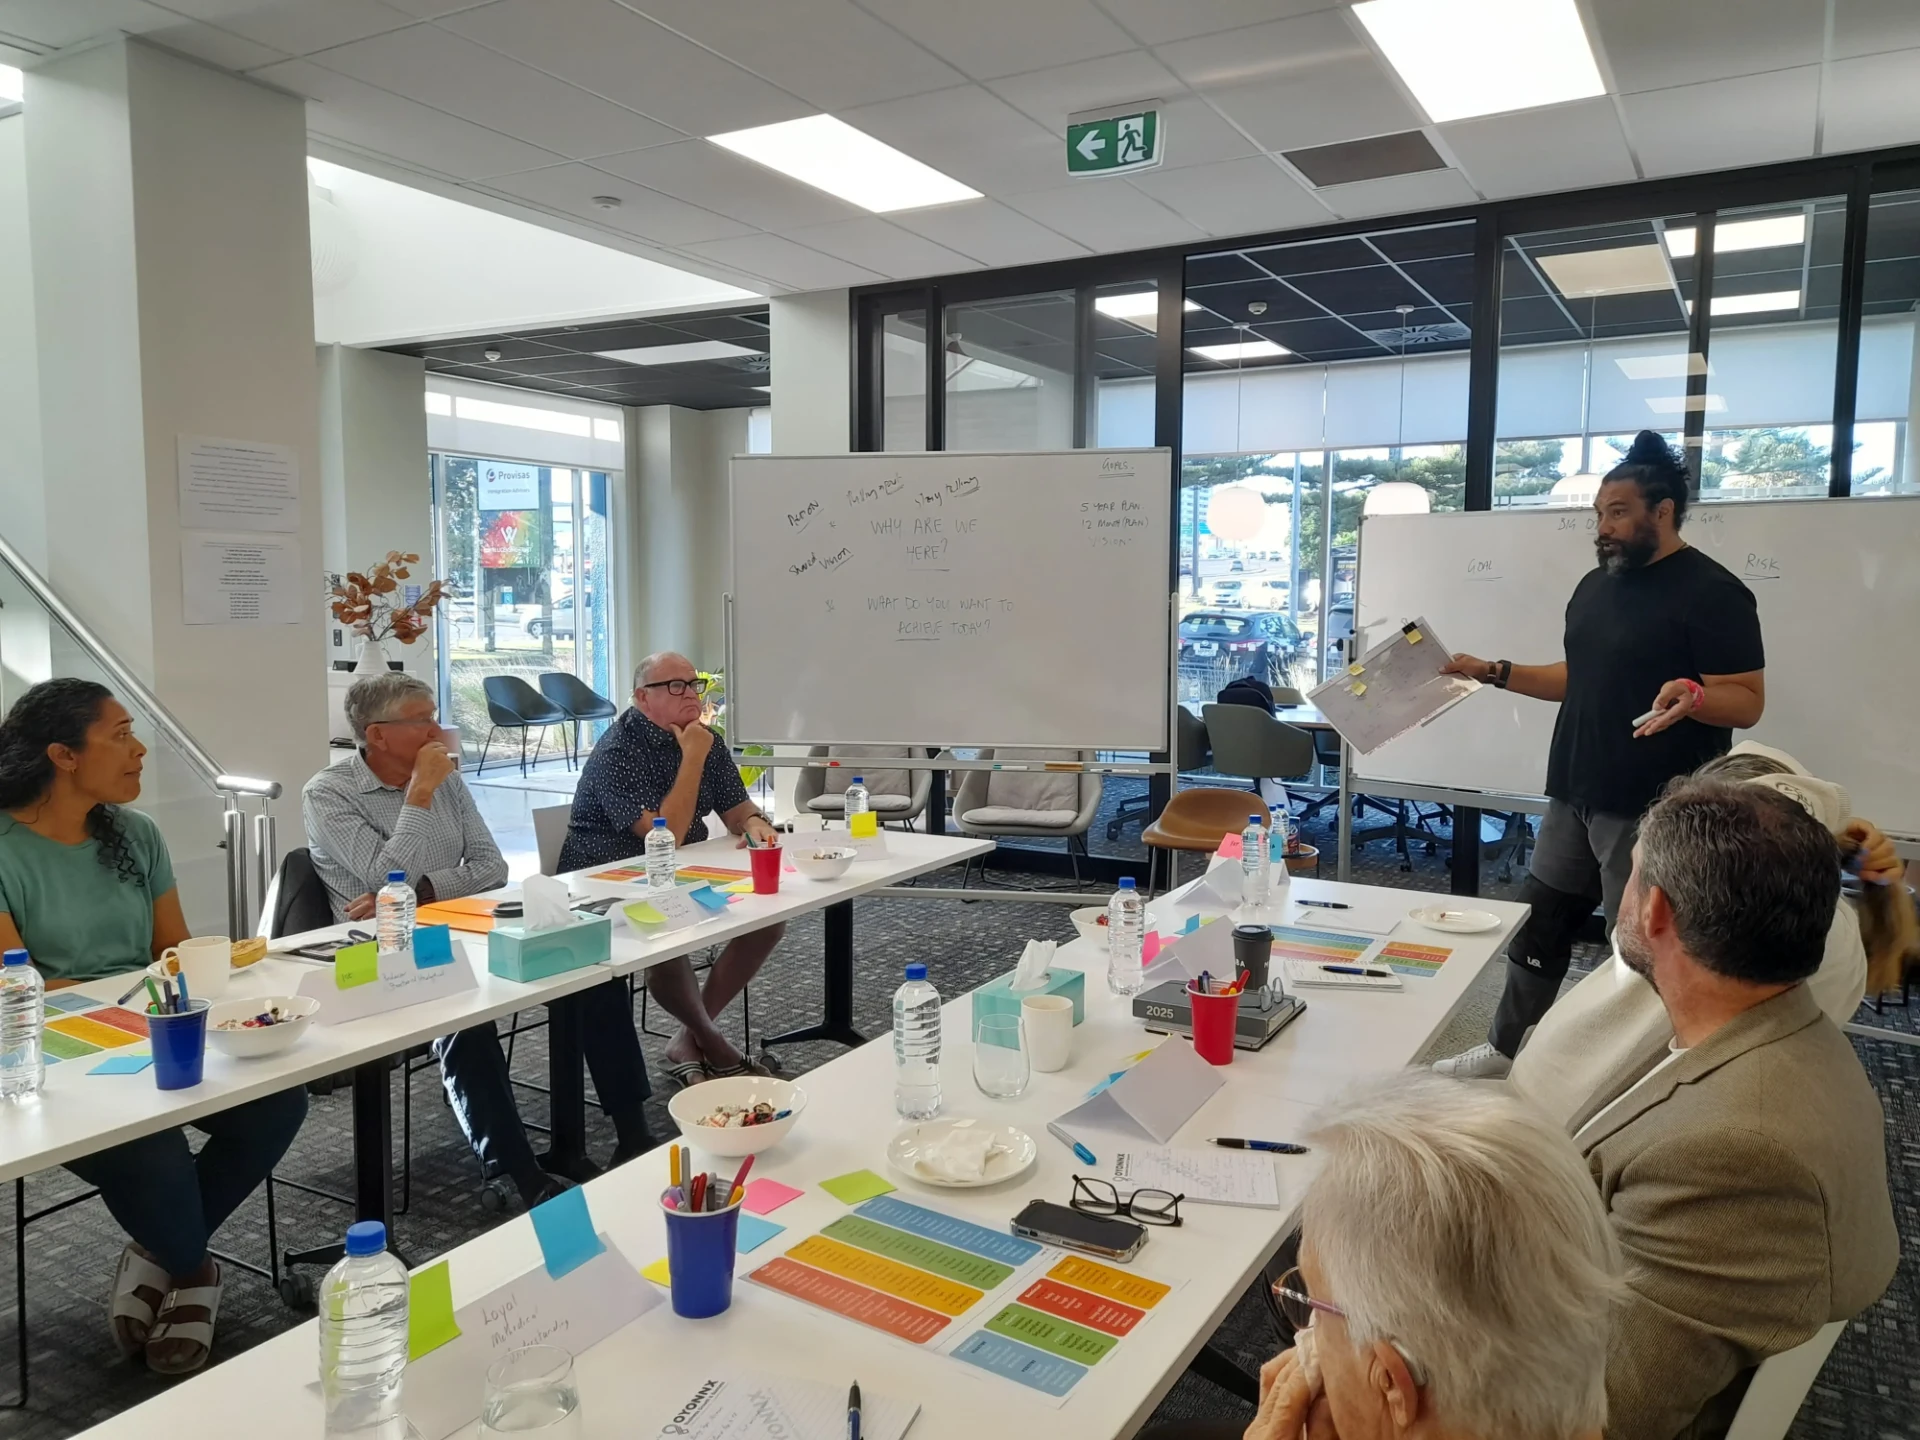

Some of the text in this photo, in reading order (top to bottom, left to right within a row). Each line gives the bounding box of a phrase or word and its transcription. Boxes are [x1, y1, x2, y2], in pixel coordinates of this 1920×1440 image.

[498, 471, 530, 480] Provisas
[1080, 502, 1089, 512] 5
[1093, 501, 1116, 512] YEAR
[870, 518, 978, 538] WHY ARE WE
[1082, 519, 1092, 530] 12
[1557, 517, 1576, 531] BIG
[906, 537, 949, 564] HERE?
[1467, 558, 1493, 575] GOAL
[1745, 553, 1781, 571] RISK
[867, 596, 1015, 612] WHAT DO YOU WANT TO
[896, 619, 944, 635] ACHIEVE
[1146, 1005, 1174, 1019] 2025
[1114, 1153, 1126, 1177] OYONNX
[482, 1292, 517, 1326] Loyal
[491, 1303, 538, 1348] Methodical
[673, 1379, 719, 1424] OYONNX
